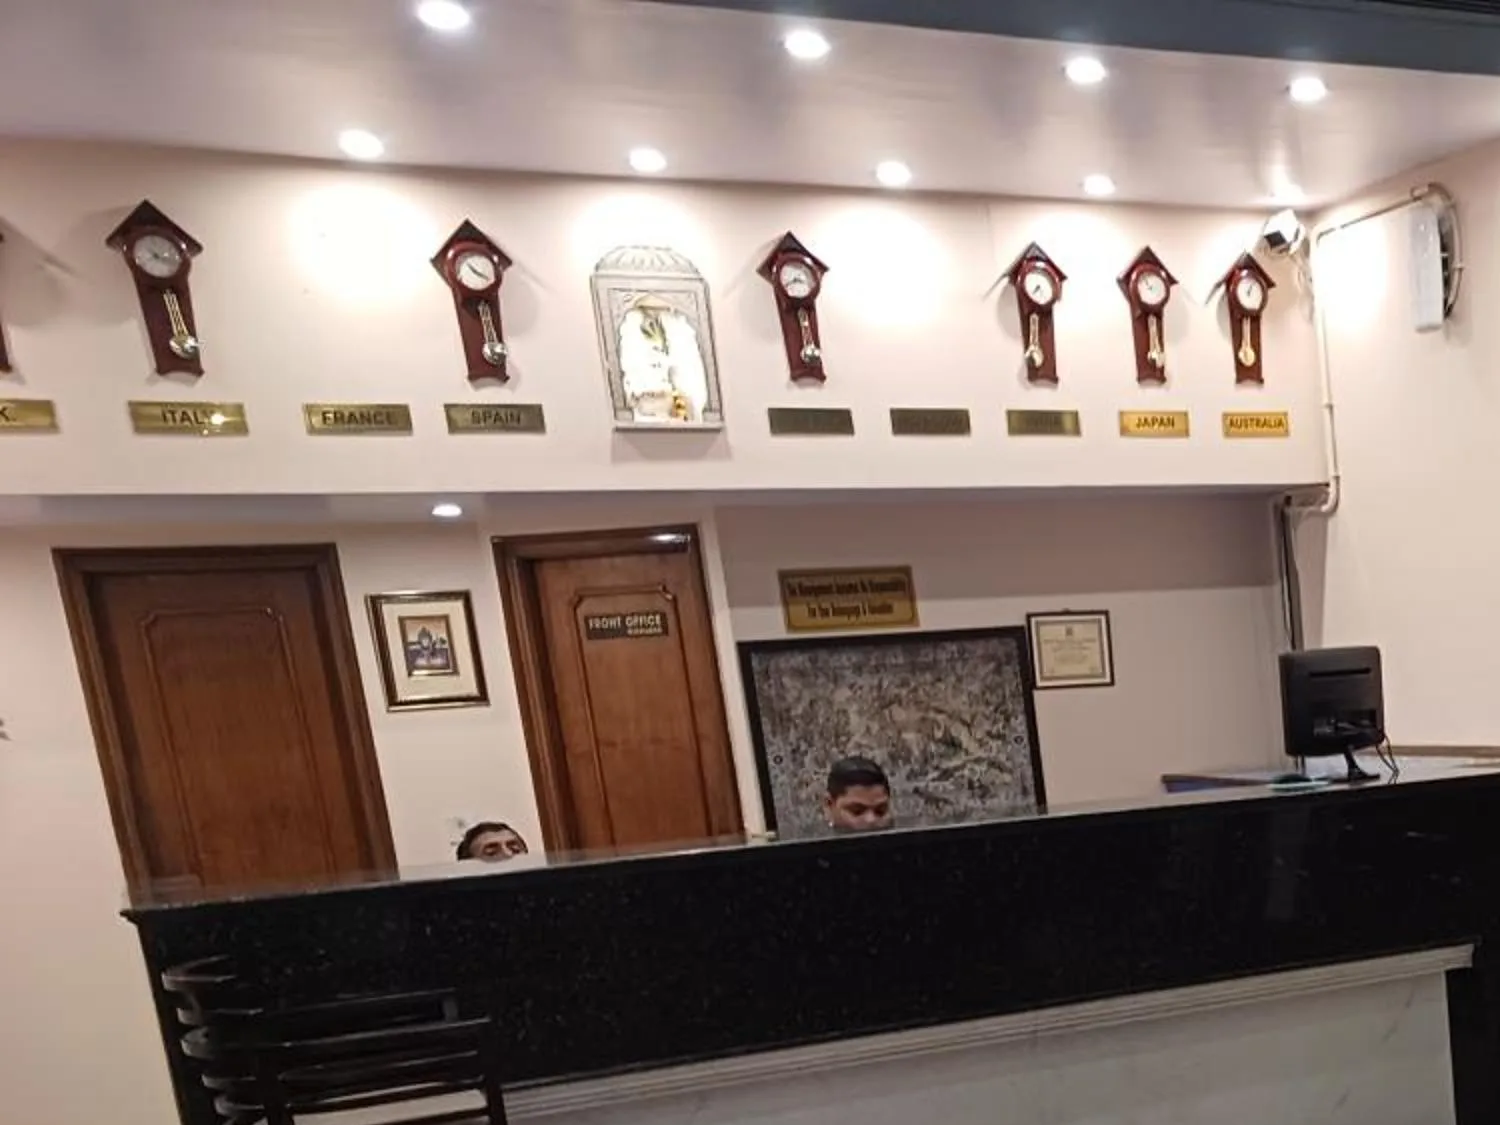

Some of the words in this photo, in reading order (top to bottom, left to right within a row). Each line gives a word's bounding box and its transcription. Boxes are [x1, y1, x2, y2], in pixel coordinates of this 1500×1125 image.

[321, 409, 395, 425] FRANCE
[470, 410, 520, 425] SPAIN
[1135, 415, 1175, 429] JAPAN
[1227, 416, 1284, 429] AUSTRALIA
[588, 616, 621, 630] FRONT
[625, 613, 661, 628] OFFICE
